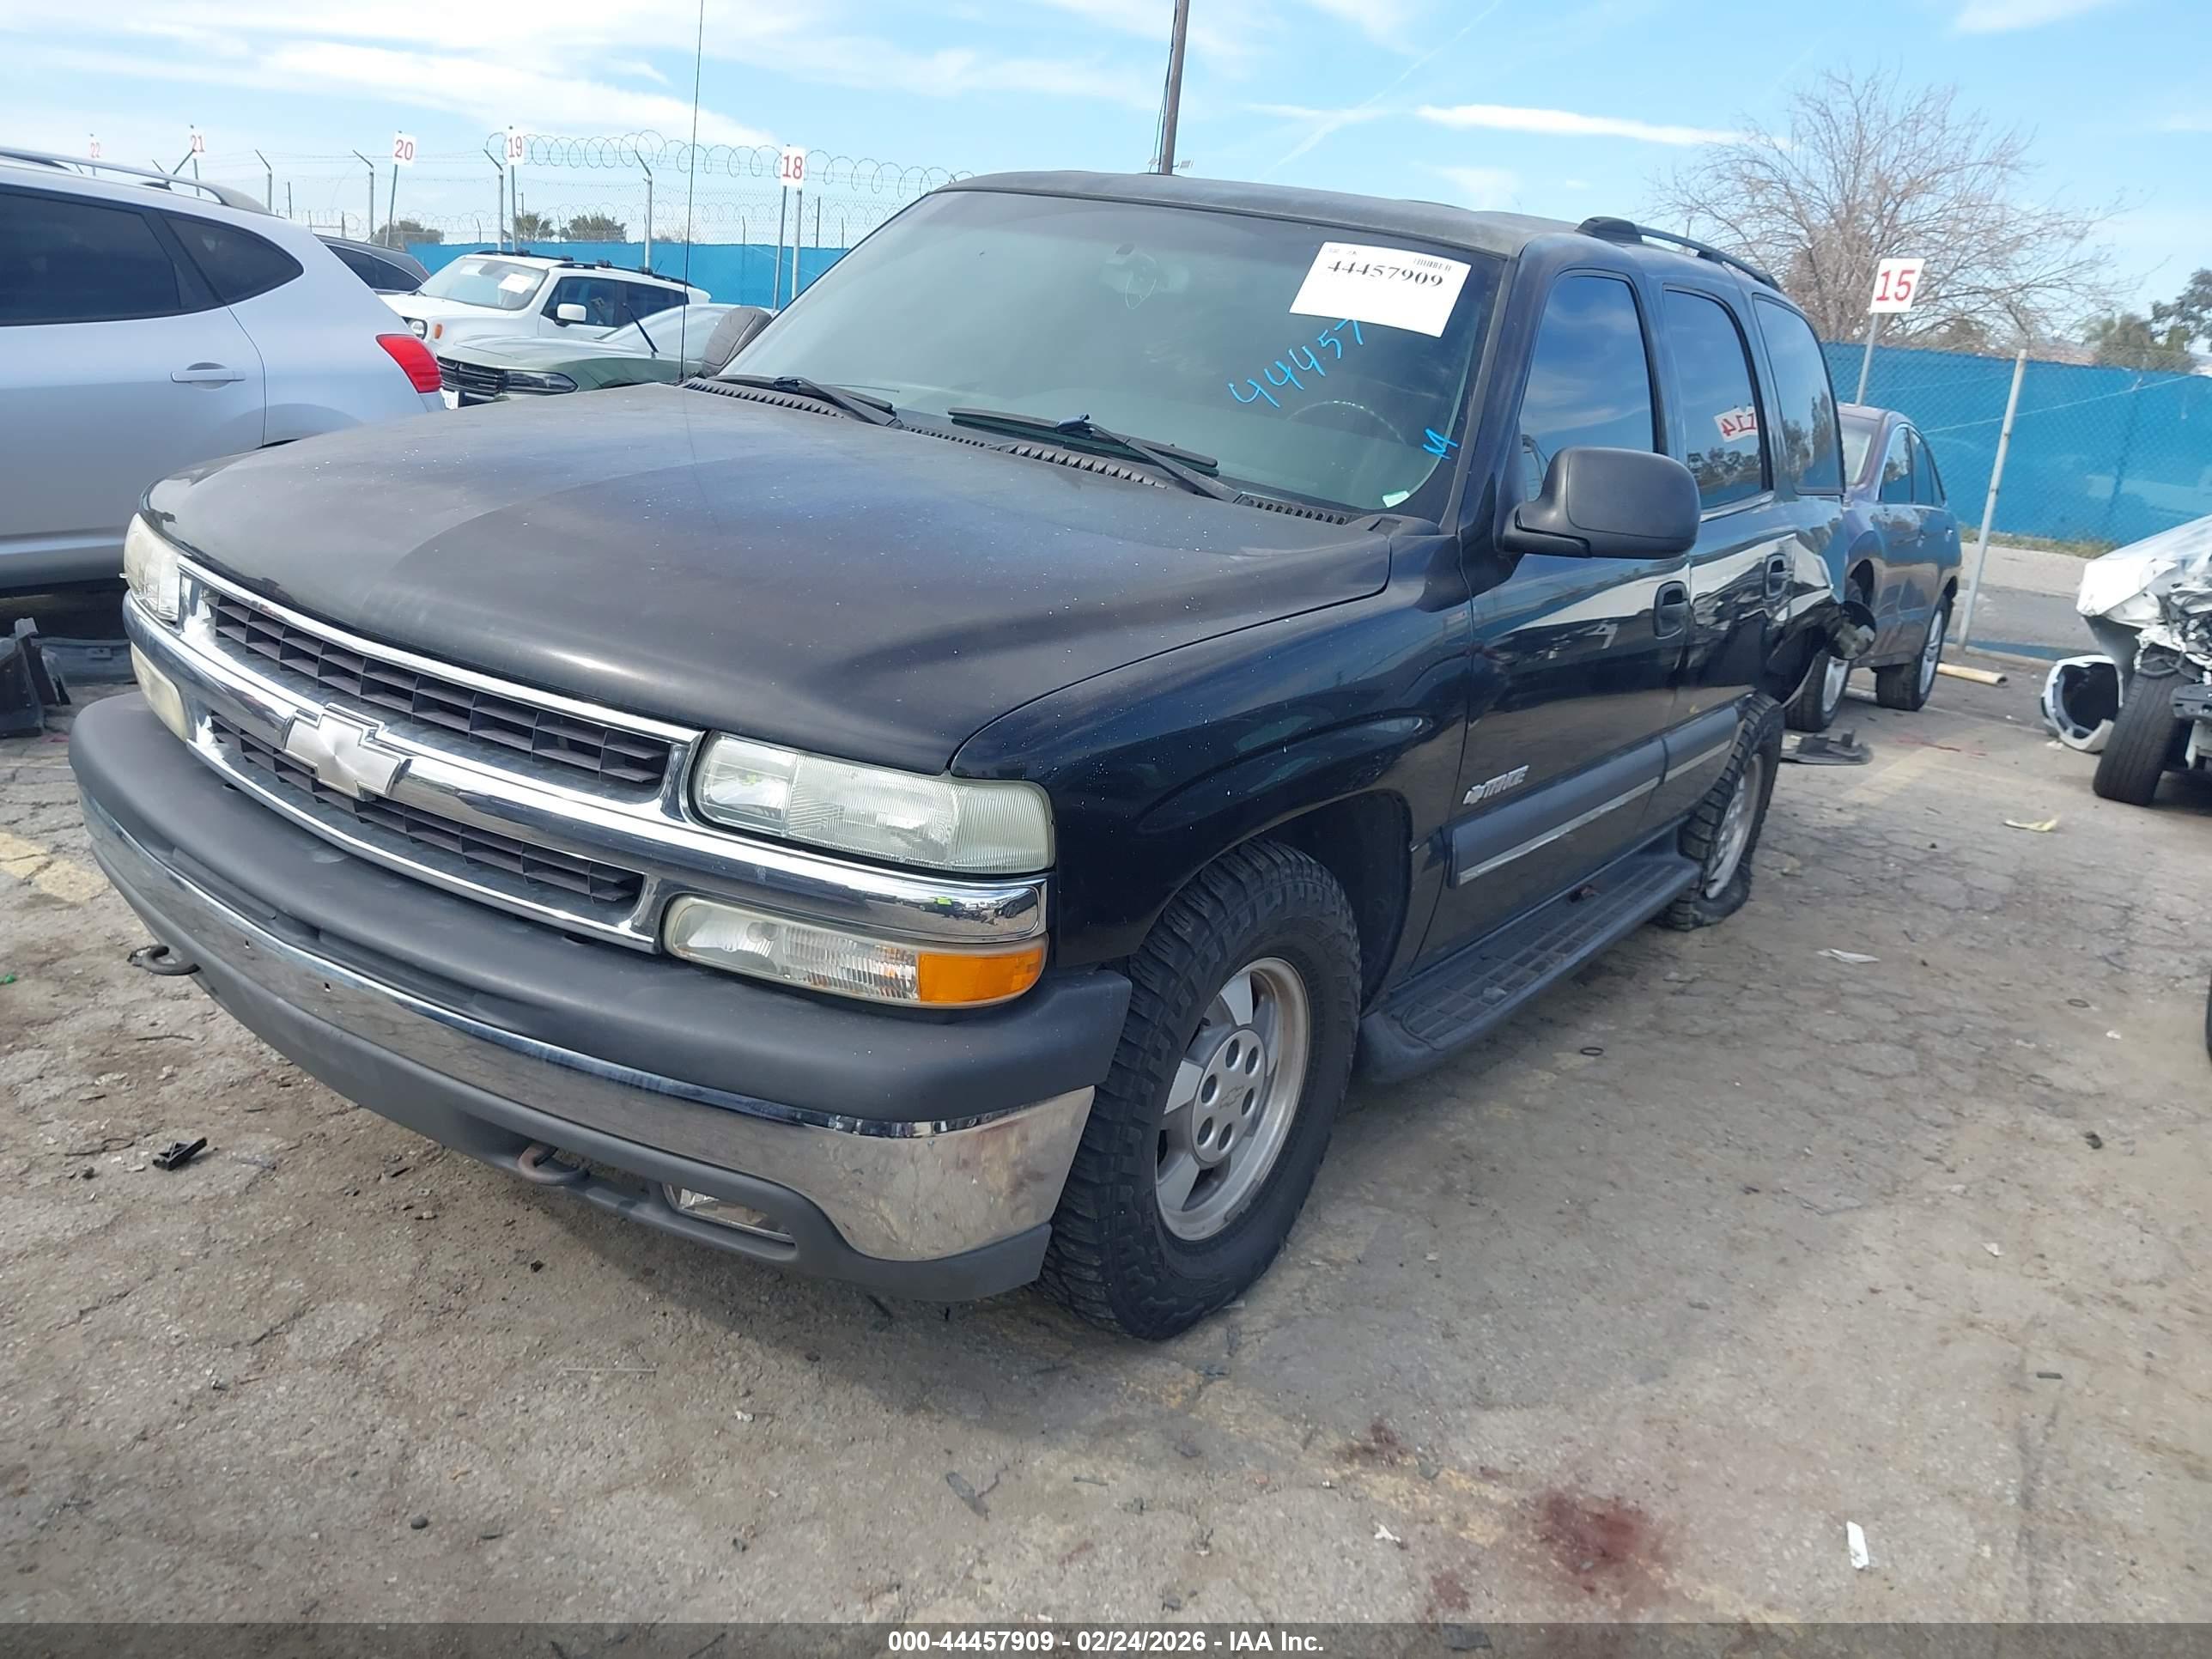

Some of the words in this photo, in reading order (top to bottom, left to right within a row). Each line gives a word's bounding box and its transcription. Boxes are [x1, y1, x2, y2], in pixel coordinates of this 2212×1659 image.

[394, 139, 415, 161] 20
[507, 136, 523, 159] 19
[781, 155, 804, 179] 18
[1328, 259, 1444, 288] 44457909
[1875, 268, 1917, 302] 15
